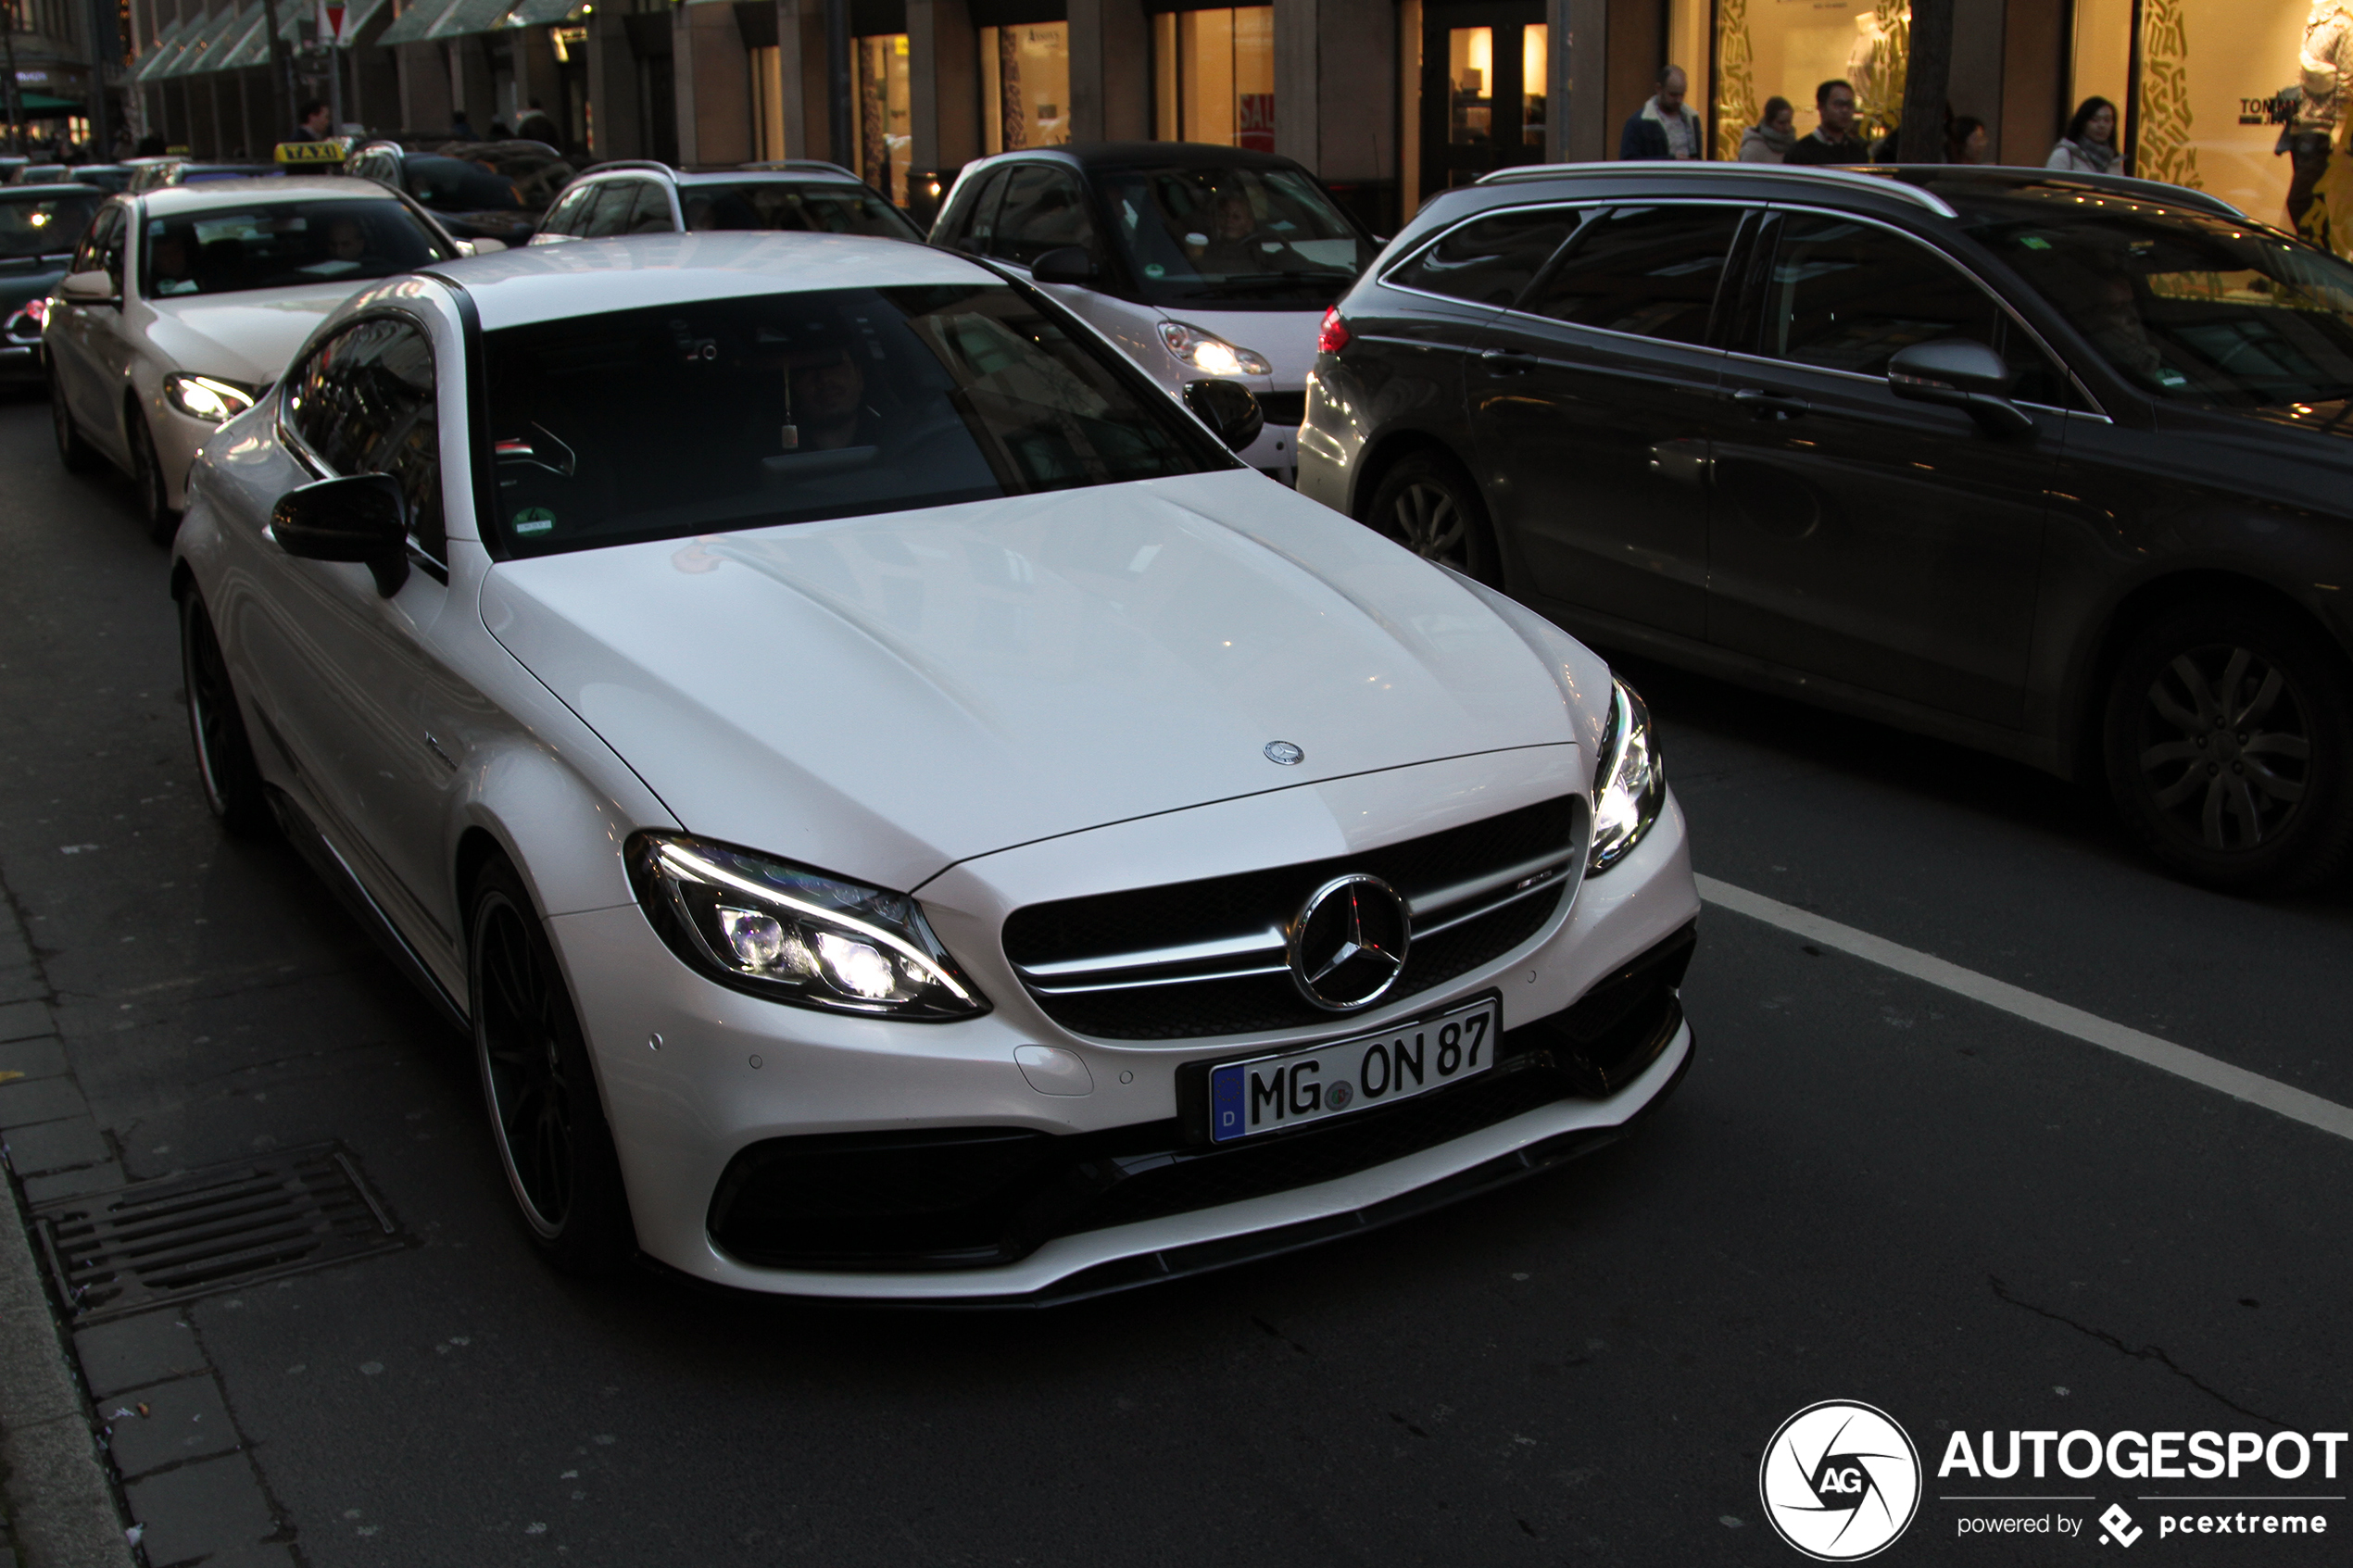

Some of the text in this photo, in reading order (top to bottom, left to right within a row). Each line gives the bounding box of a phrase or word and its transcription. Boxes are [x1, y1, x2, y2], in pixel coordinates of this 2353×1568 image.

[285, 145, 336, 159] TAXI
[1251, 1010, 1491, 1124] MG ON 87
[1223, 1110, 1235, 1127] D
